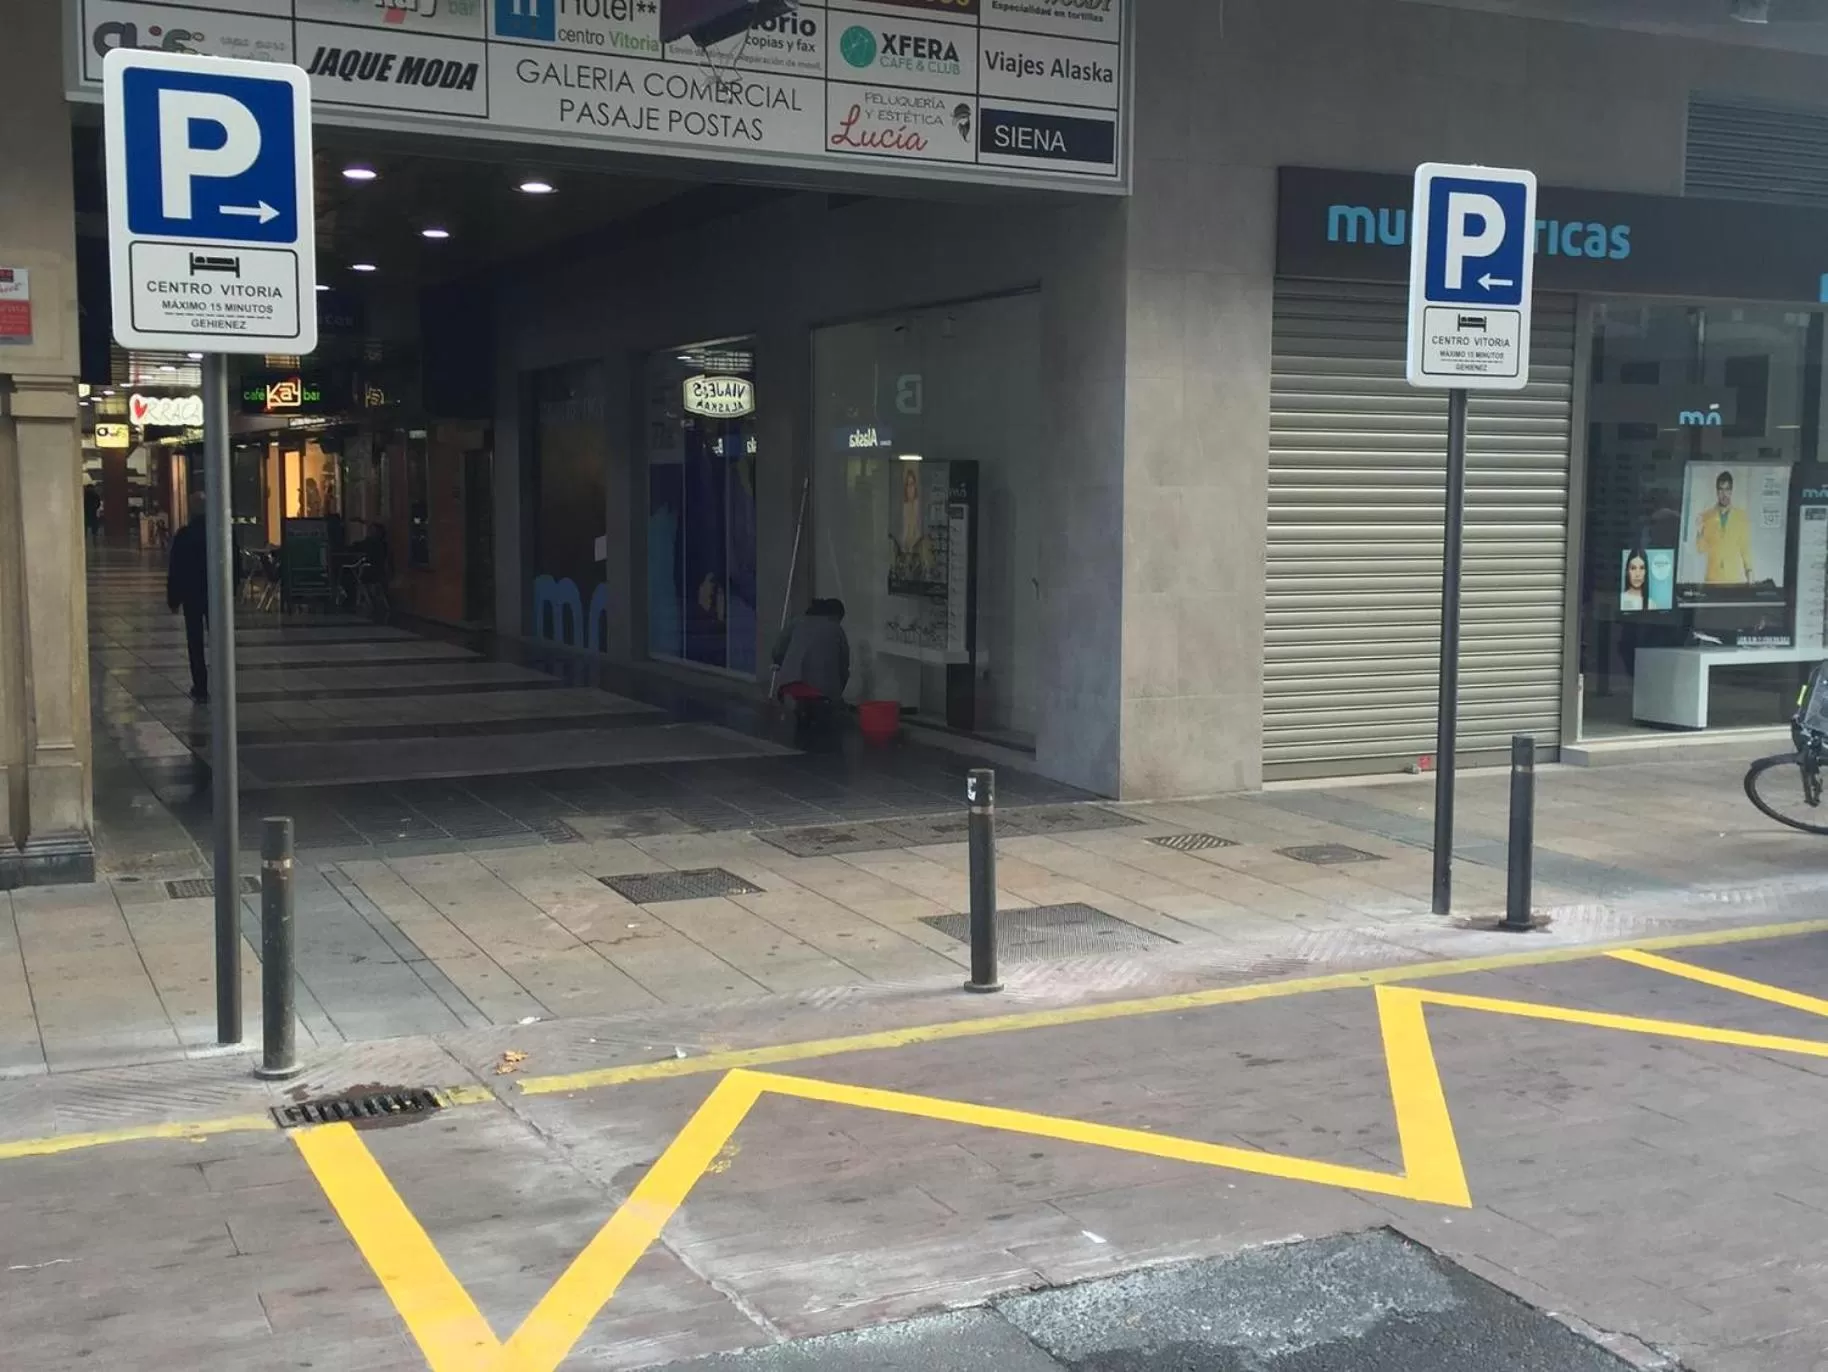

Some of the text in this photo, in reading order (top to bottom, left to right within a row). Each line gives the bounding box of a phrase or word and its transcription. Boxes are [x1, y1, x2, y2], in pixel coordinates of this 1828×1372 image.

[558, 28, 605, 46] centro
[609, 30, 660, 52] Vitoria
[745, 35, 816, 53] copias y fax
[881, 32, 960, 62] XFERA
[307, 46, 397, 82] JAQUE
[395, 55, 479, 91] MODA
[915, 59, 925, 71] &
[927, 61, 960, 76] CLUB
[984, 49, 1113, 83] Viajes Alaska
[515, 58, 802, 112] GALERIA COMERCIAL
[864, 91, 945, 110] PELUQUERÍA
[560, 98, 763, 141] PASAJE POSTAS
[831, 103, 928, 151] Lucía
[865, 109, 944, 126] Y ESTÉTICA
[994, 124, 1068, 153] SIENA
[158, 88, 262, 220] P
[1444, 191, 1506, 290] P
[147, 280, 283, 299] CENTRO VITORIA
[161, 299, 274, 315] MÁXIMO 15 MINUTOS
[190, 319, 248, 331] GEHIENEZ
[1431, 335, 1511, 348] CENTRO VITORIA
[243, 387, 266, 401] café
[303, 387, 322, 401] bar
